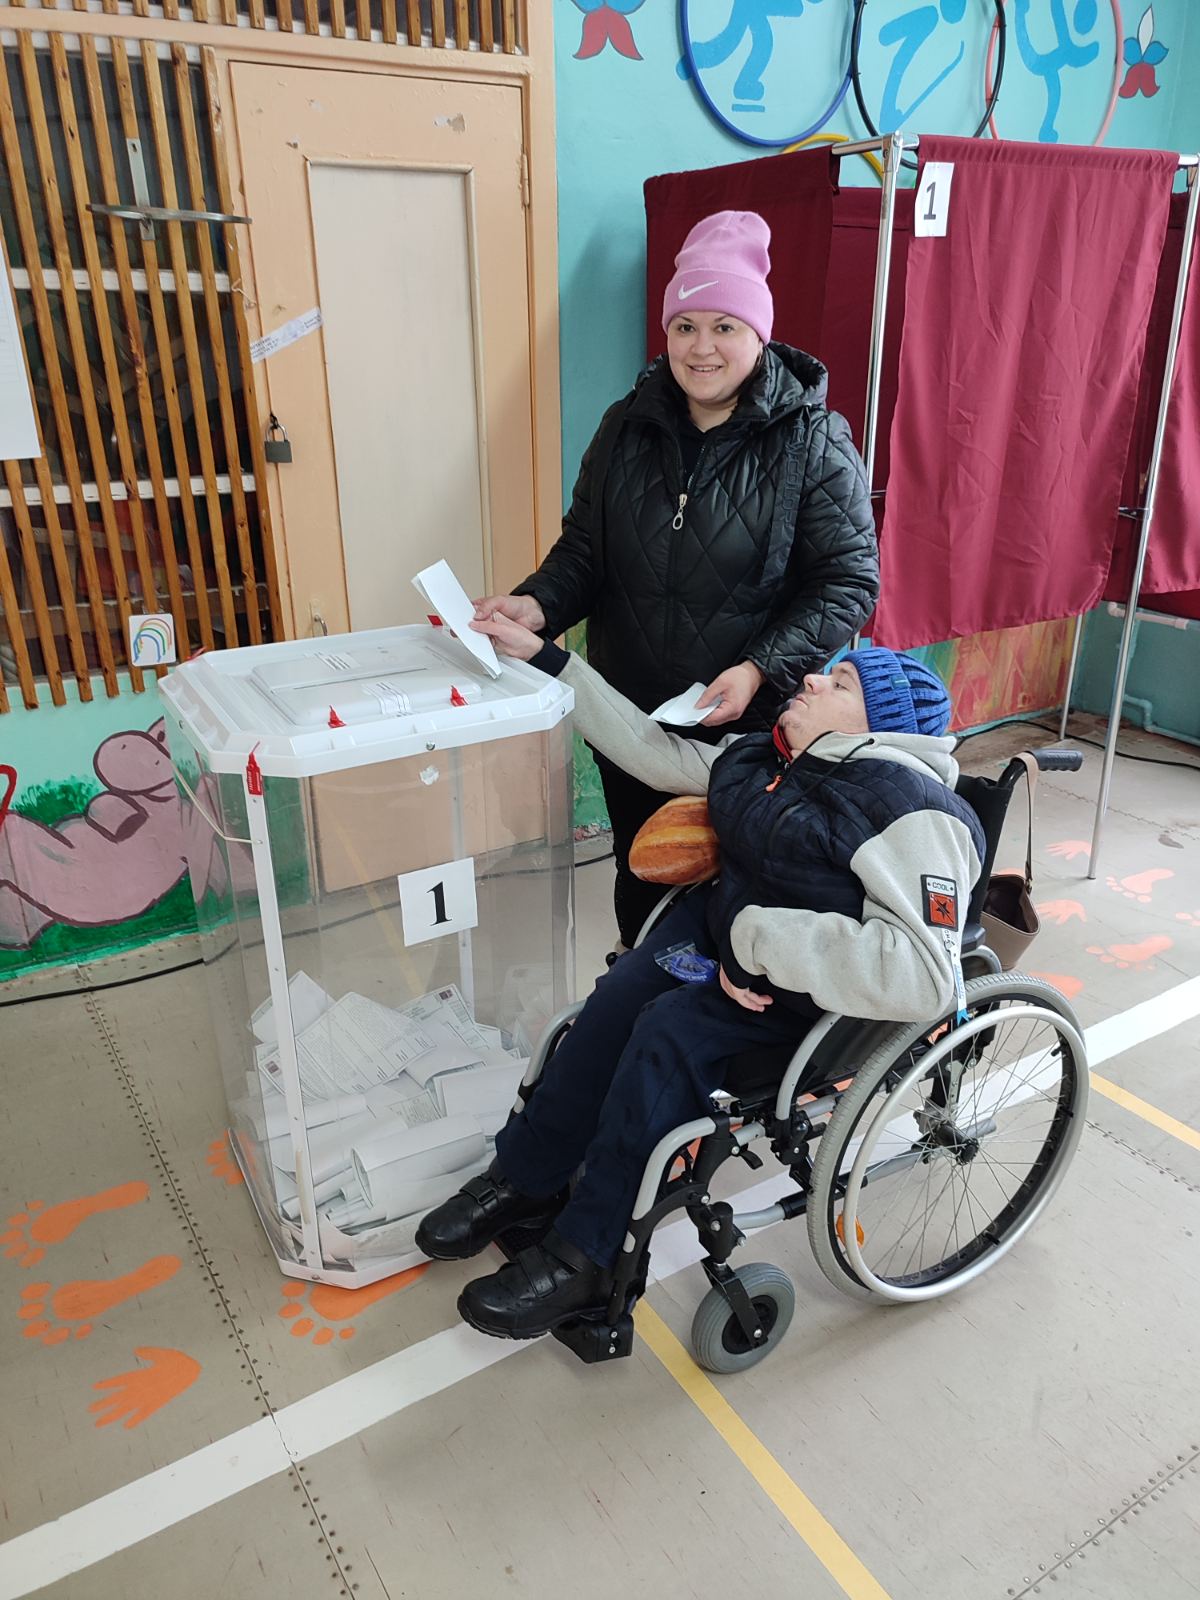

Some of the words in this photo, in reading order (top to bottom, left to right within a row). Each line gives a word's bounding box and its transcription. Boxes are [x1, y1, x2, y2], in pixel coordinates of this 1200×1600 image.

[924, 181, 937, 220] 1
[426, 881, 453, 926] 1
[932, 881, 950, 892] COOL
